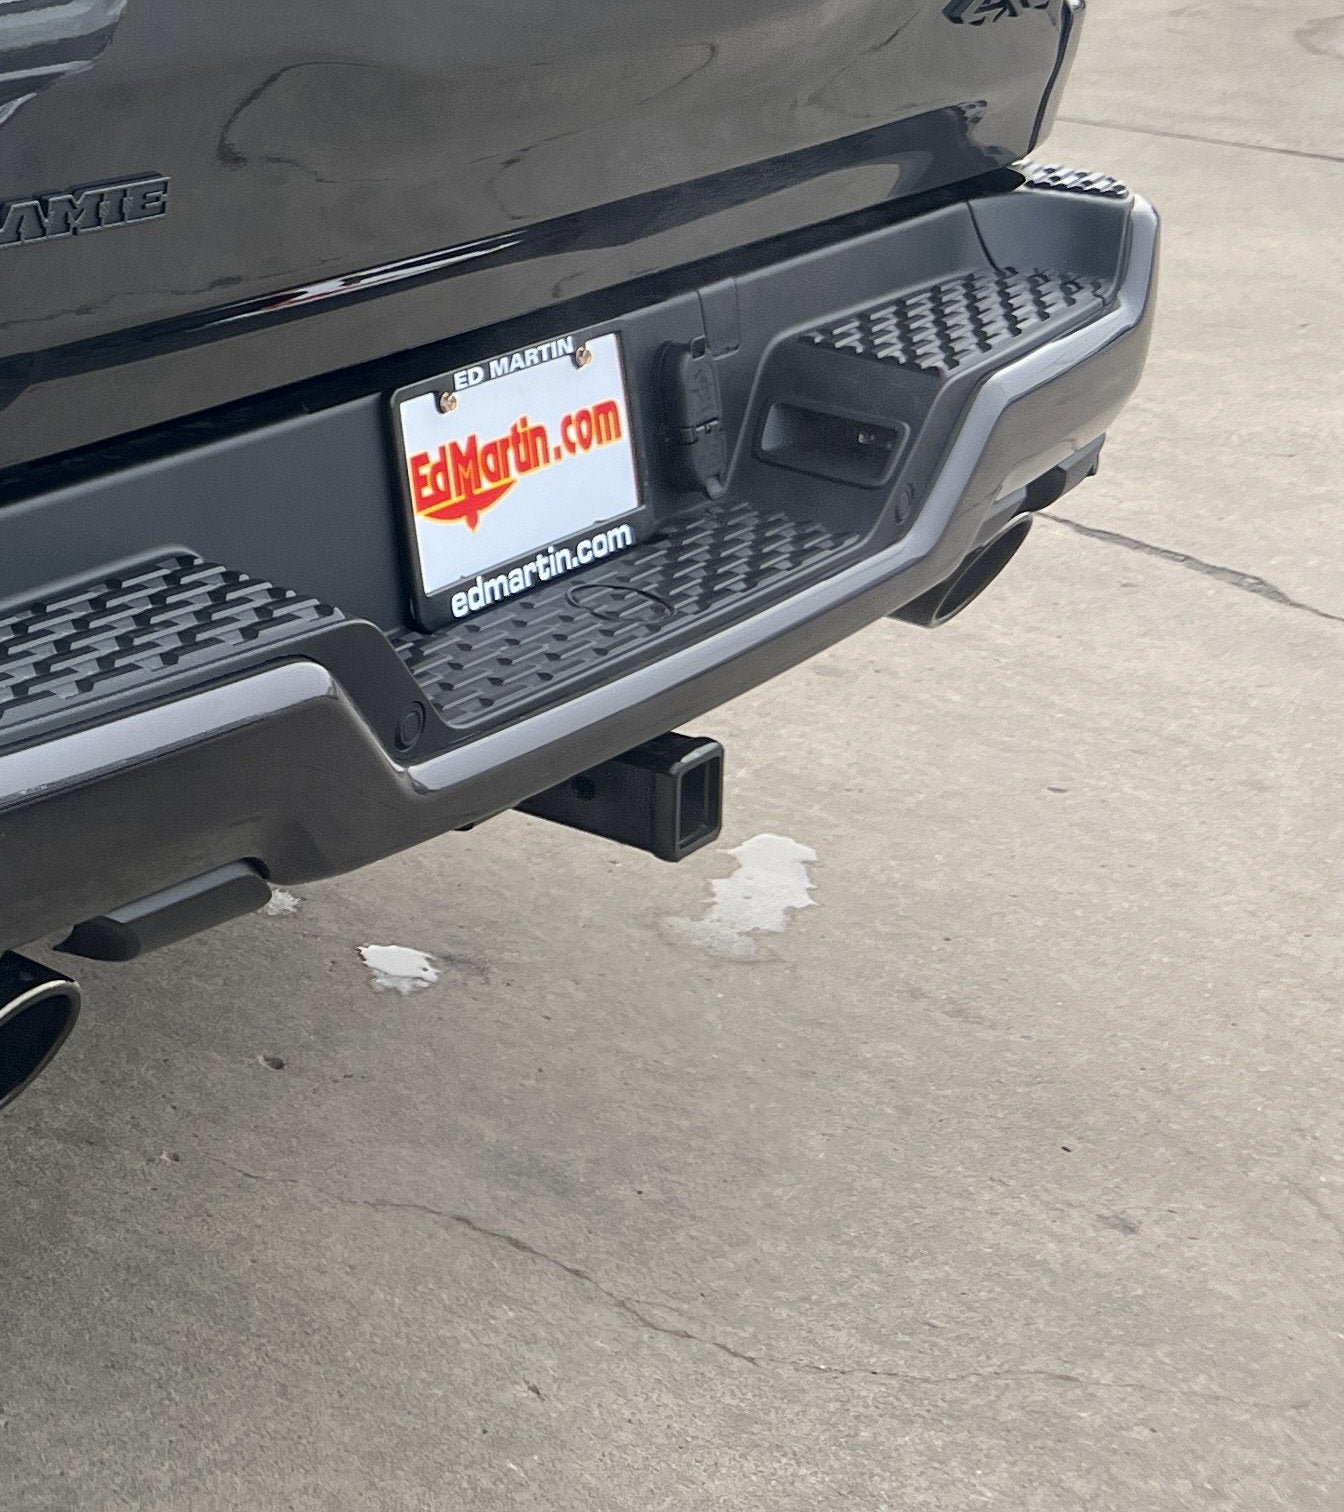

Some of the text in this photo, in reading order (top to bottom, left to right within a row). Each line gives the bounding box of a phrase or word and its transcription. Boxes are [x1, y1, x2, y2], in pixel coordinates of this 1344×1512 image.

[453, 335, 576, 391] ED MARTIN
[409, 398, 623, 516] EdMartin.com
[450, 522, 635, 619] edmartin.com
